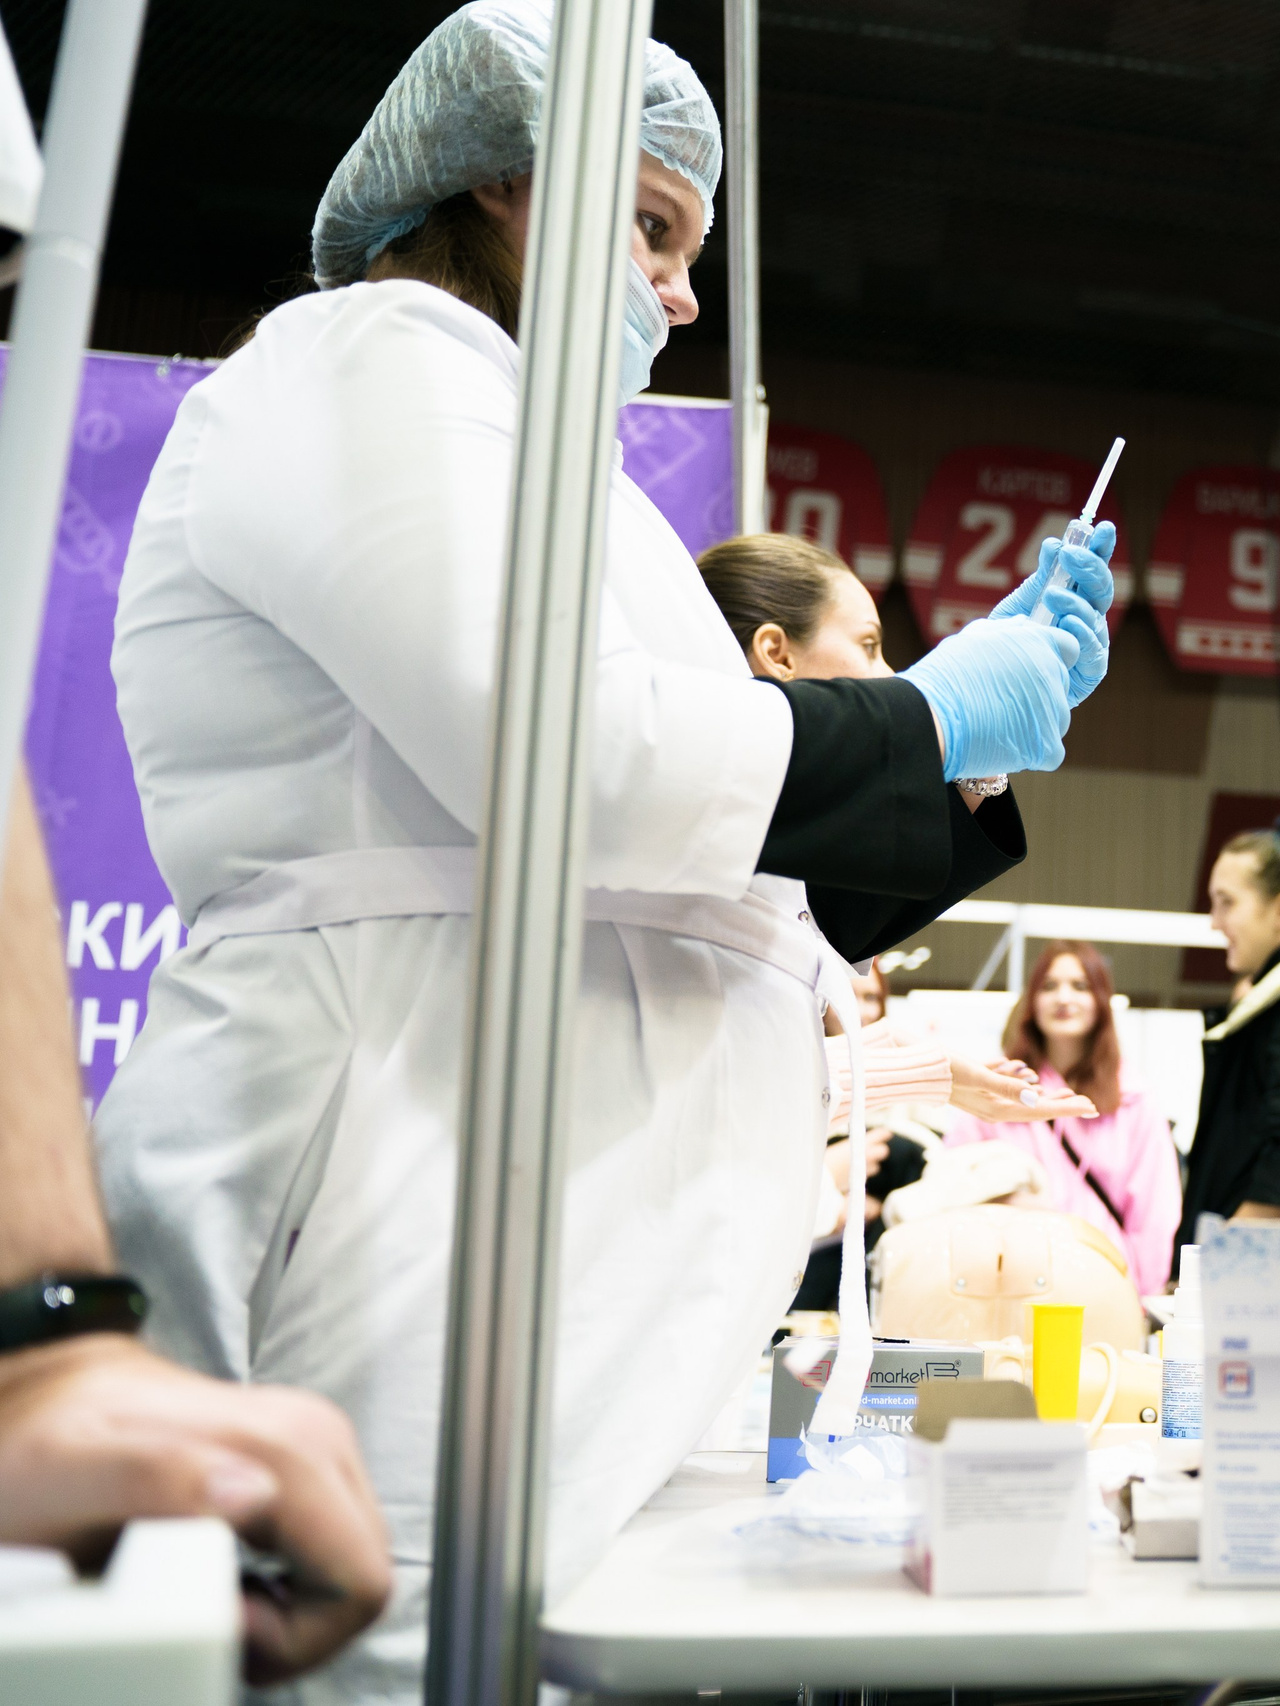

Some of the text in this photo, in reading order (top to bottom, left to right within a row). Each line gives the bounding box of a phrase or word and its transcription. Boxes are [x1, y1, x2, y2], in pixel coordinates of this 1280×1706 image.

[766, 486, 843, 552] 0
[64, 899, 182, 971] КИ
[78, 996, 140, 1068] Н
[866, 1367, 925, 1384] market
[861, 1395, 918, 1406] d-market.onl
[854, 1414, 918, 1433] РЧАТК
